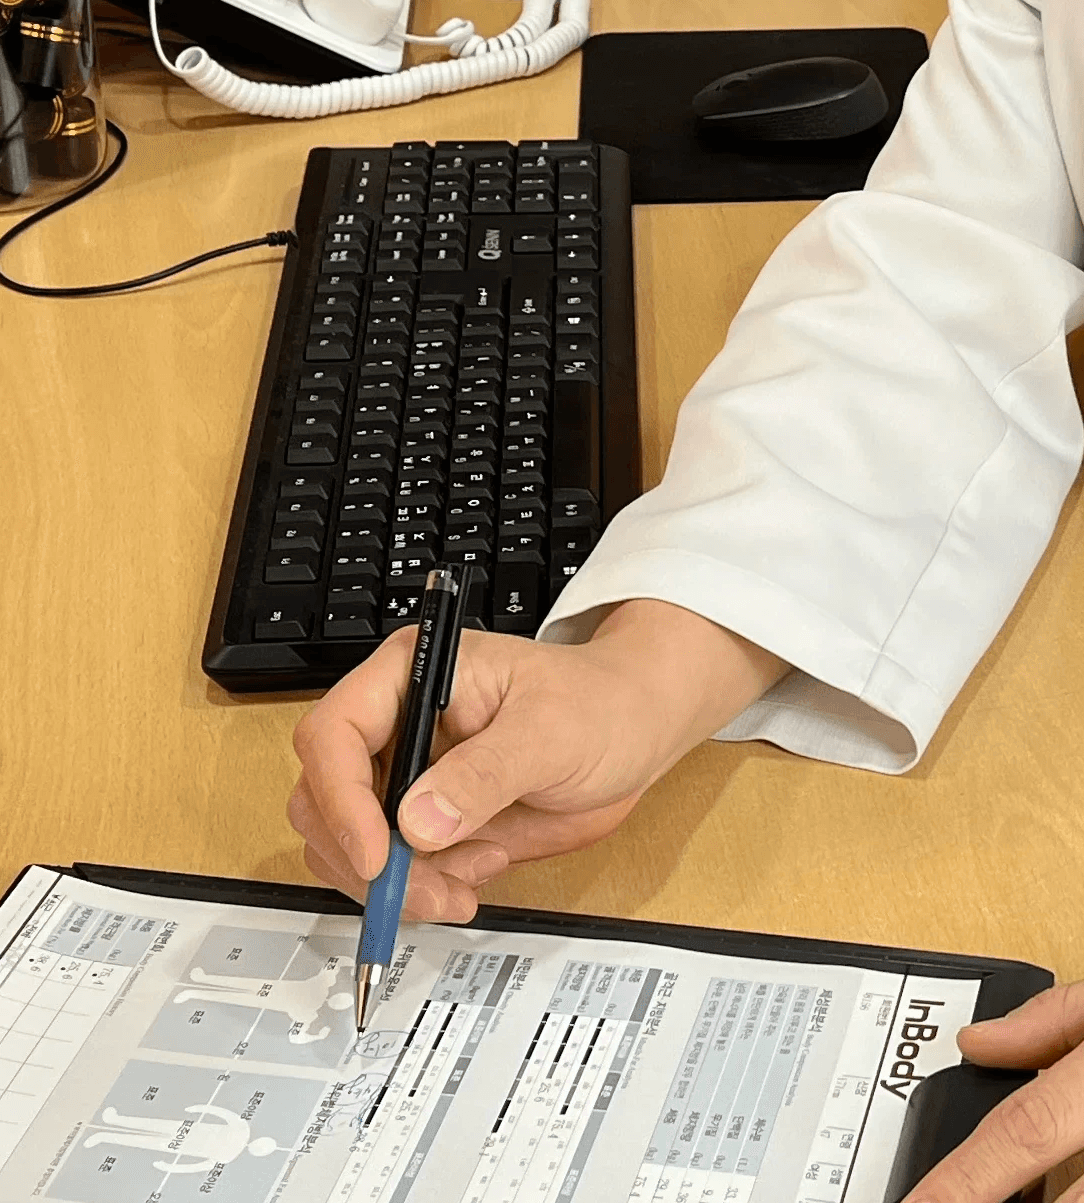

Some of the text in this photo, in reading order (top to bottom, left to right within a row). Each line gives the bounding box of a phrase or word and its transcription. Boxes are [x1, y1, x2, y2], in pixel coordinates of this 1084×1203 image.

[270, 611, 282, 621] Esc
[412, 619, 433, 684] Juice up 04
[151, 921, 180, 953] 신체변화
[224, 947, 244, 961] 표준
[58, 961, 84, 980] 25.6
[90, 967, 115, 985] 75.4
[510, 956, 535, 990] 비만분석
[254, 982, 275, 997] 표준
[185, 1010, 206, 1025] 표준
[811, 989, 834, 1032] 체성분분석
[287, 1021, 304, 1036] 표준
[880, 999, 945, 1100] InBody
[139, 1085, 160, 1101] 표준
[532, 1082, 552, 1103] 25.6
[238, 1090, 266, 1120] 표준이상
[392, 1100, 415, 1121] 25.8
[299, 1081, 347, 1154] 부위별체지방분석
[703, 1113, 723, 1137] 무기질
[164, 1119, 196, 1150] 표준이상
[546, 1118, 566, 1139] 75.4
[96, 1155, 119, 1173] 표준
